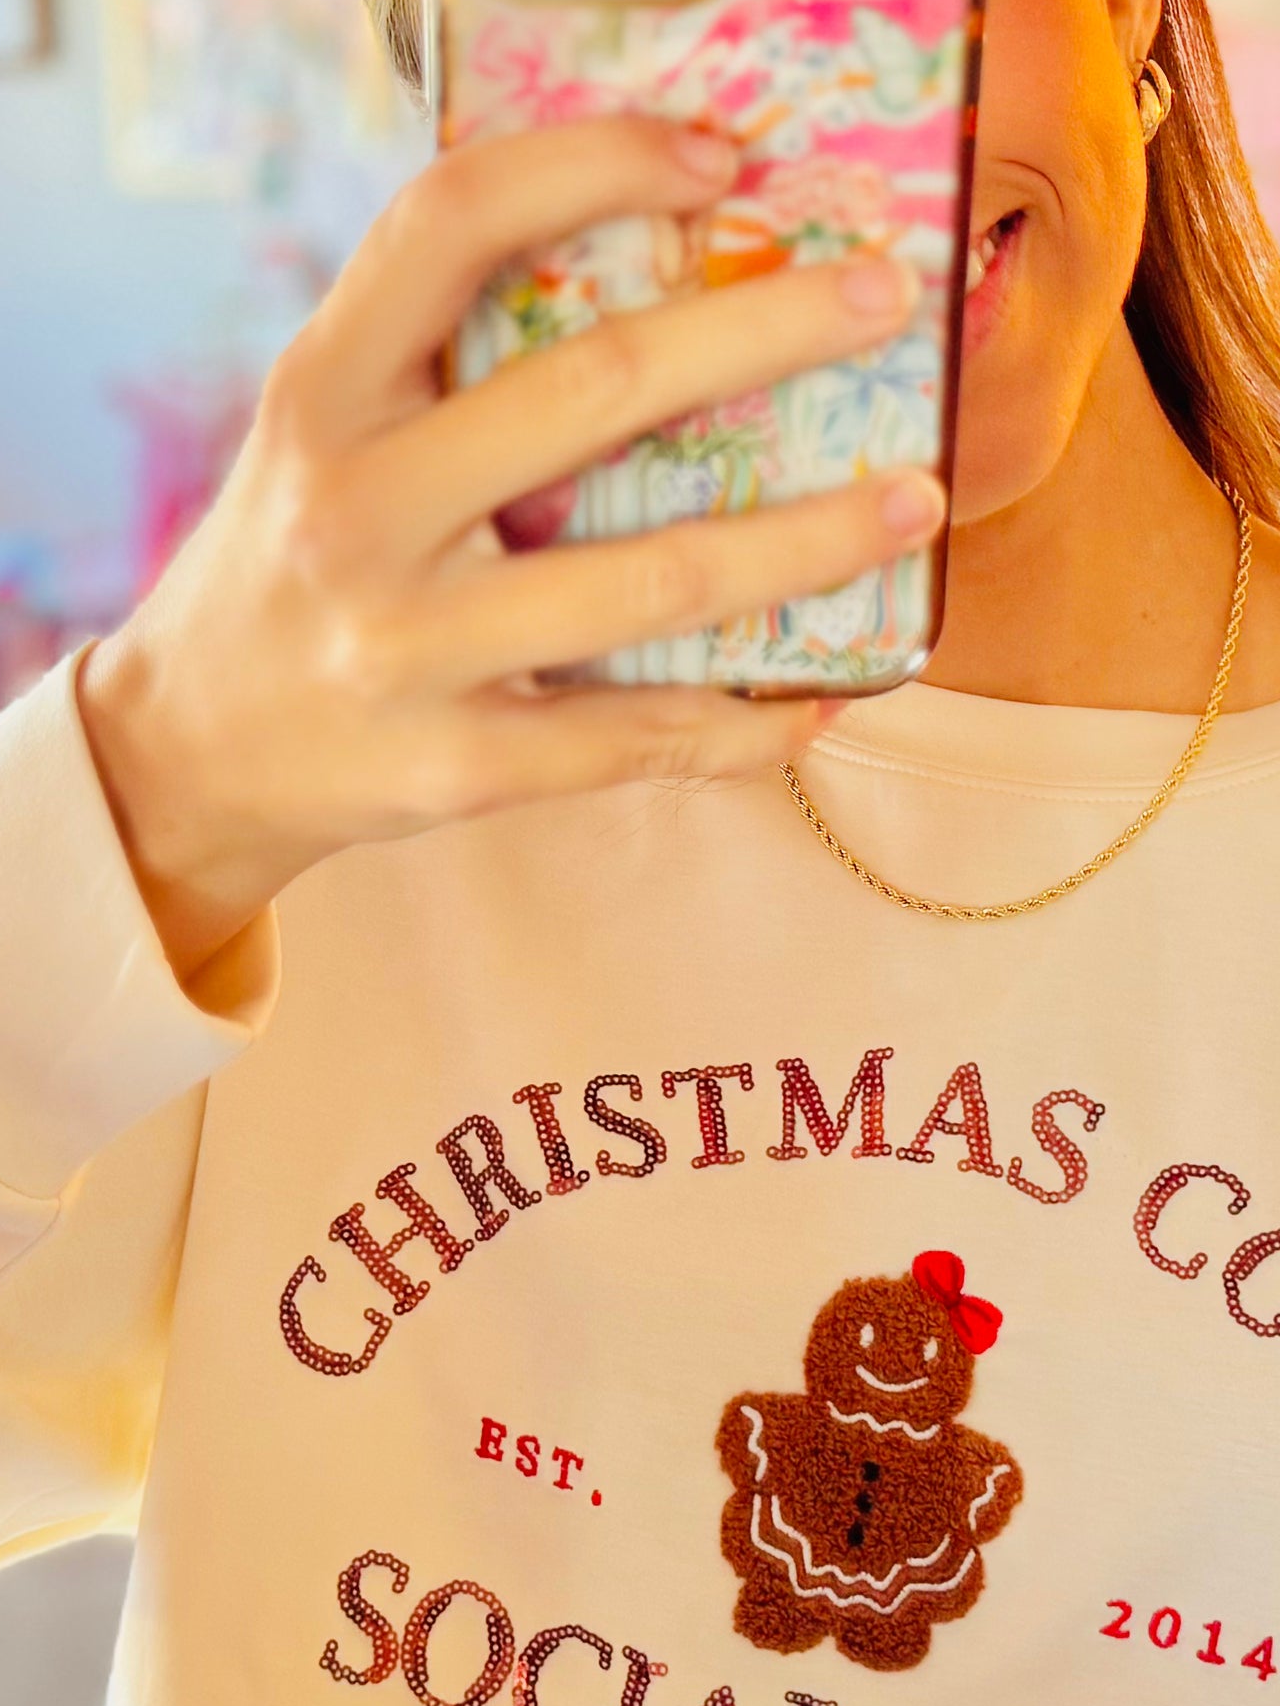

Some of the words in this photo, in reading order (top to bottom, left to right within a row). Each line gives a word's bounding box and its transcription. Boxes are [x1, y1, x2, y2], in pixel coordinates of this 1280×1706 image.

[279, 1047, 1105, 1377] CHRISTMAS
[474, 1417, 604, 1507] EST.
[1099, 1599, 1278, 1682] 2014
